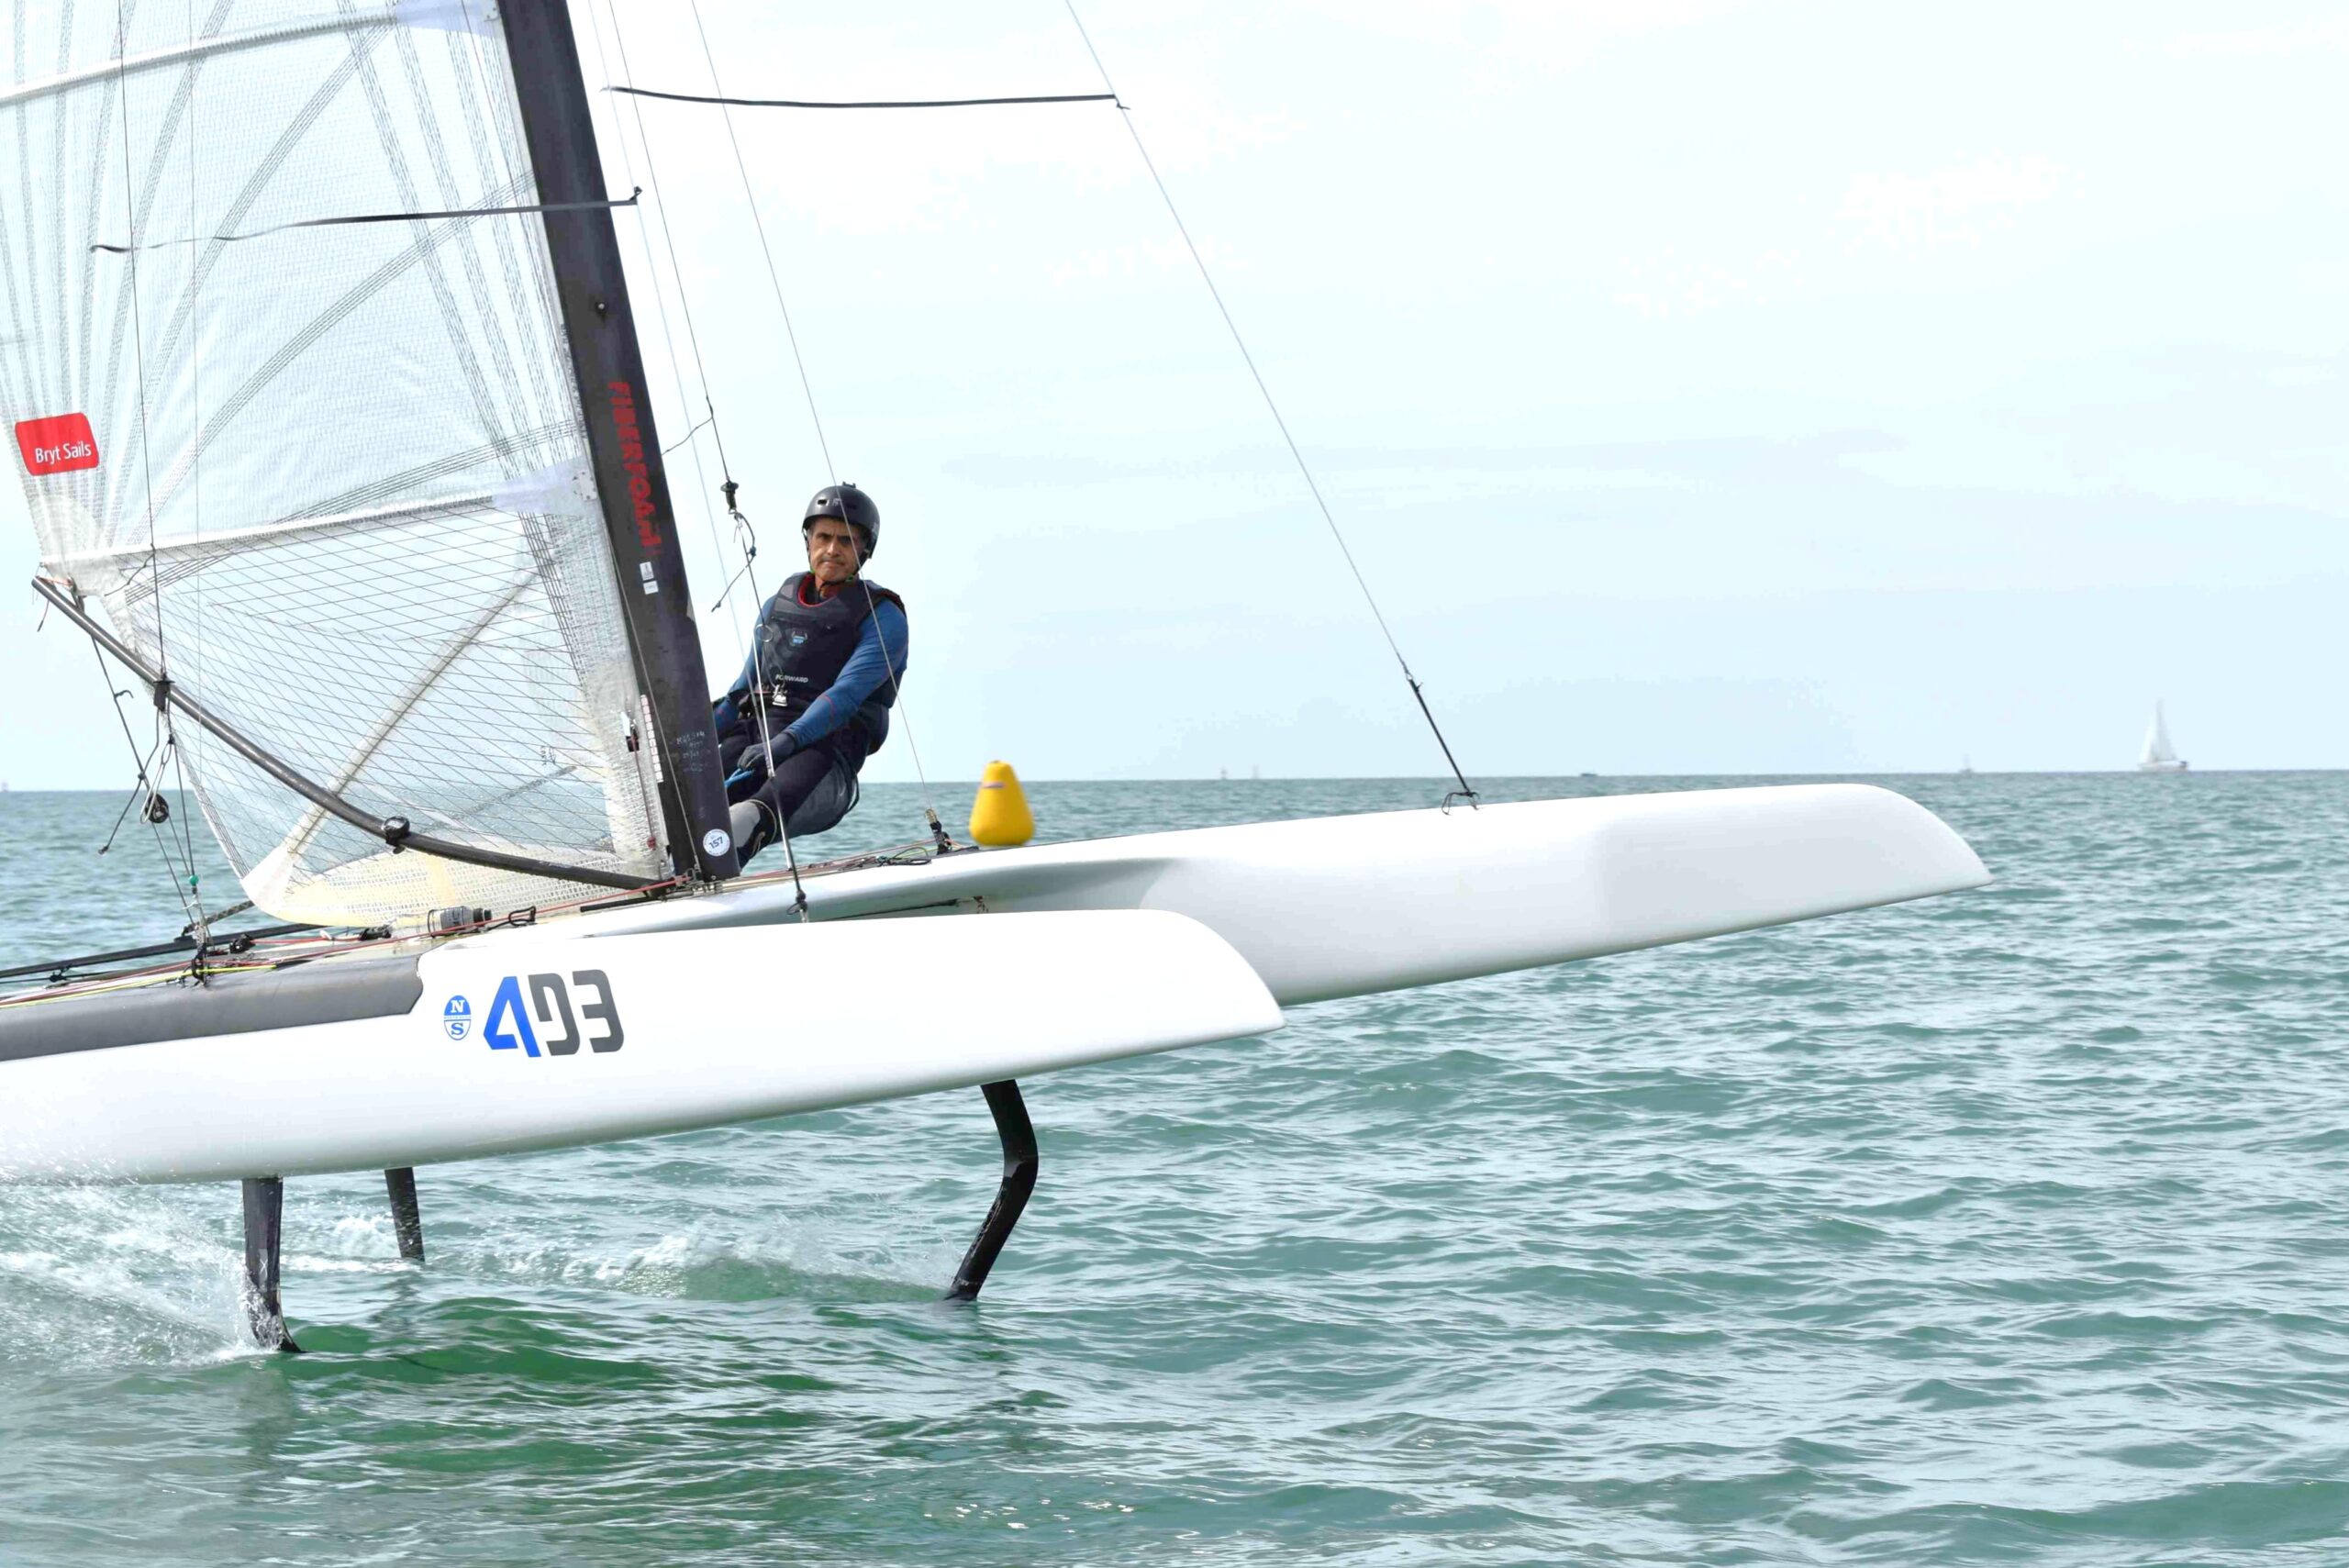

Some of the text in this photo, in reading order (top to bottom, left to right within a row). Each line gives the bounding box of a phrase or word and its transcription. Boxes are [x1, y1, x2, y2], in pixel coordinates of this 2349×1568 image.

[35, 440, 92, 465] Bryt Sails
[775, 673, 808, 683] FORWARD
[708, 836, 723, 849] 157
[450, 999, 465, 1013] N
[451, 1022, 464, 1036] S
